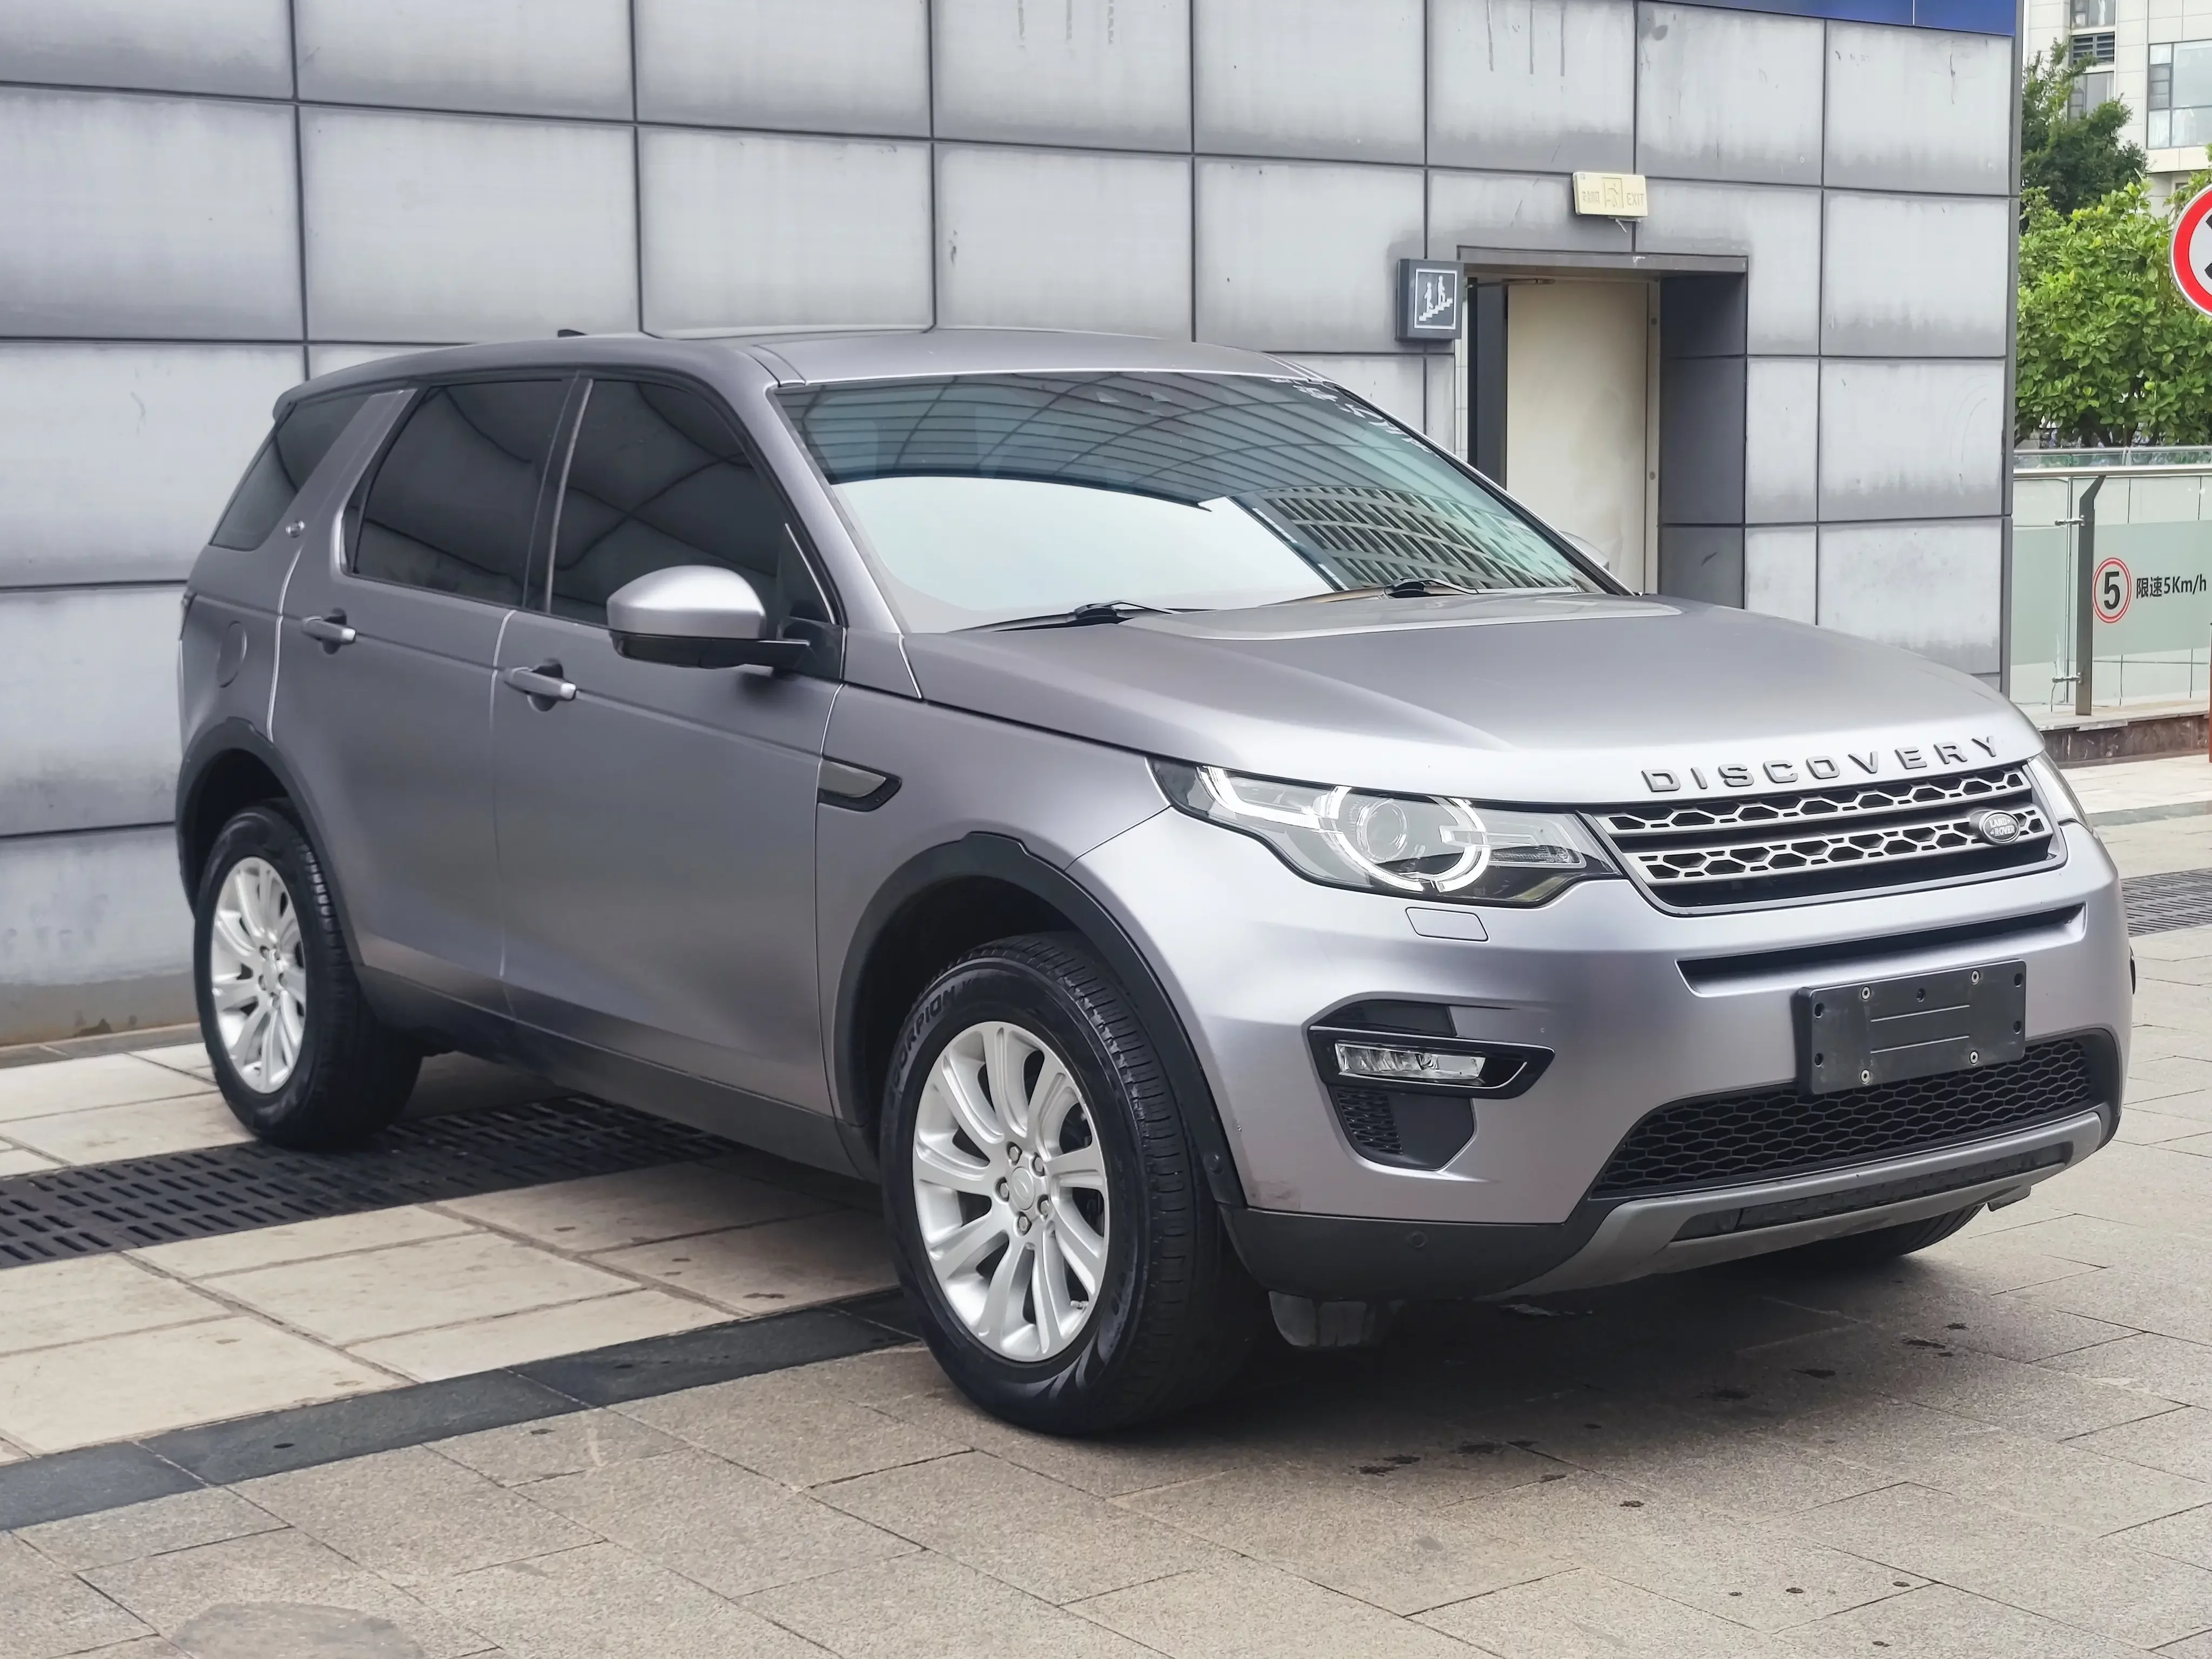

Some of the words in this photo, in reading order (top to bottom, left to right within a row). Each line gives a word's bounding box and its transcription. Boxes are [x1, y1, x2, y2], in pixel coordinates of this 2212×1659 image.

[1627, 193, 1644, 205] EXIT
[2104, 571, 2120, 610] 5
[2136, 574, 2207, 599] 限速5Km/h
[1641, 735, 1997, 792] DISCOVERY
[1989, 818, 2007, 828] LAND
[1994, 825, 2015, 837] ROVER
